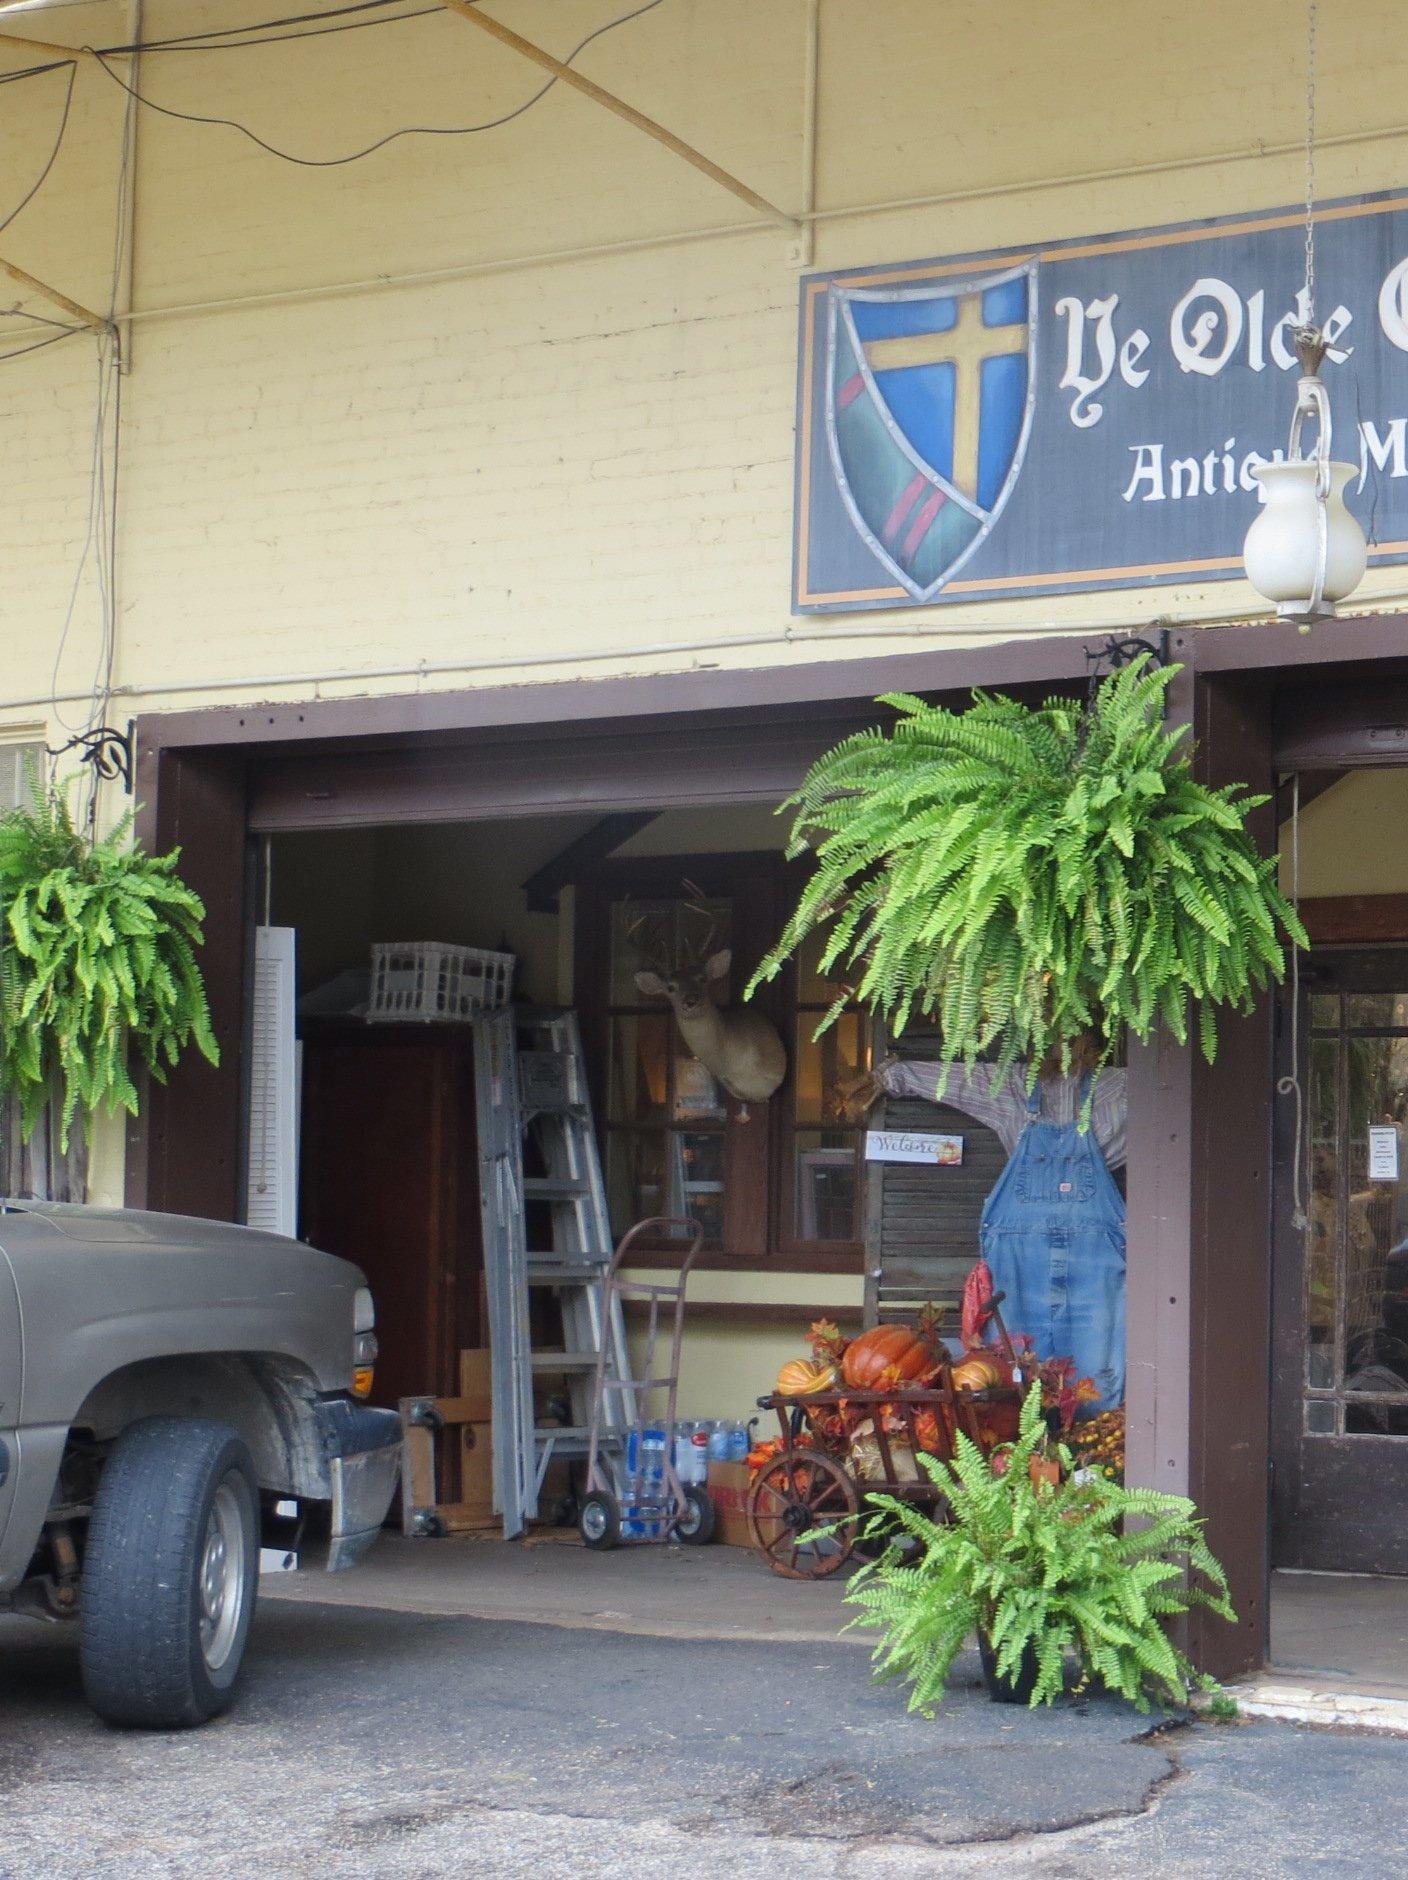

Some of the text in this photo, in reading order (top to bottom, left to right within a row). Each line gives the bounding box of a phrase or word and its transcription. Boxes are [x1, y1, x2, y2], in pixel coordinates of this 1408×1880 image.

[1055, 294, 1151, 428] Ye
[1170, 278, 1354, 376] Olde
[1122, 437, 1320, 504] Antiq
